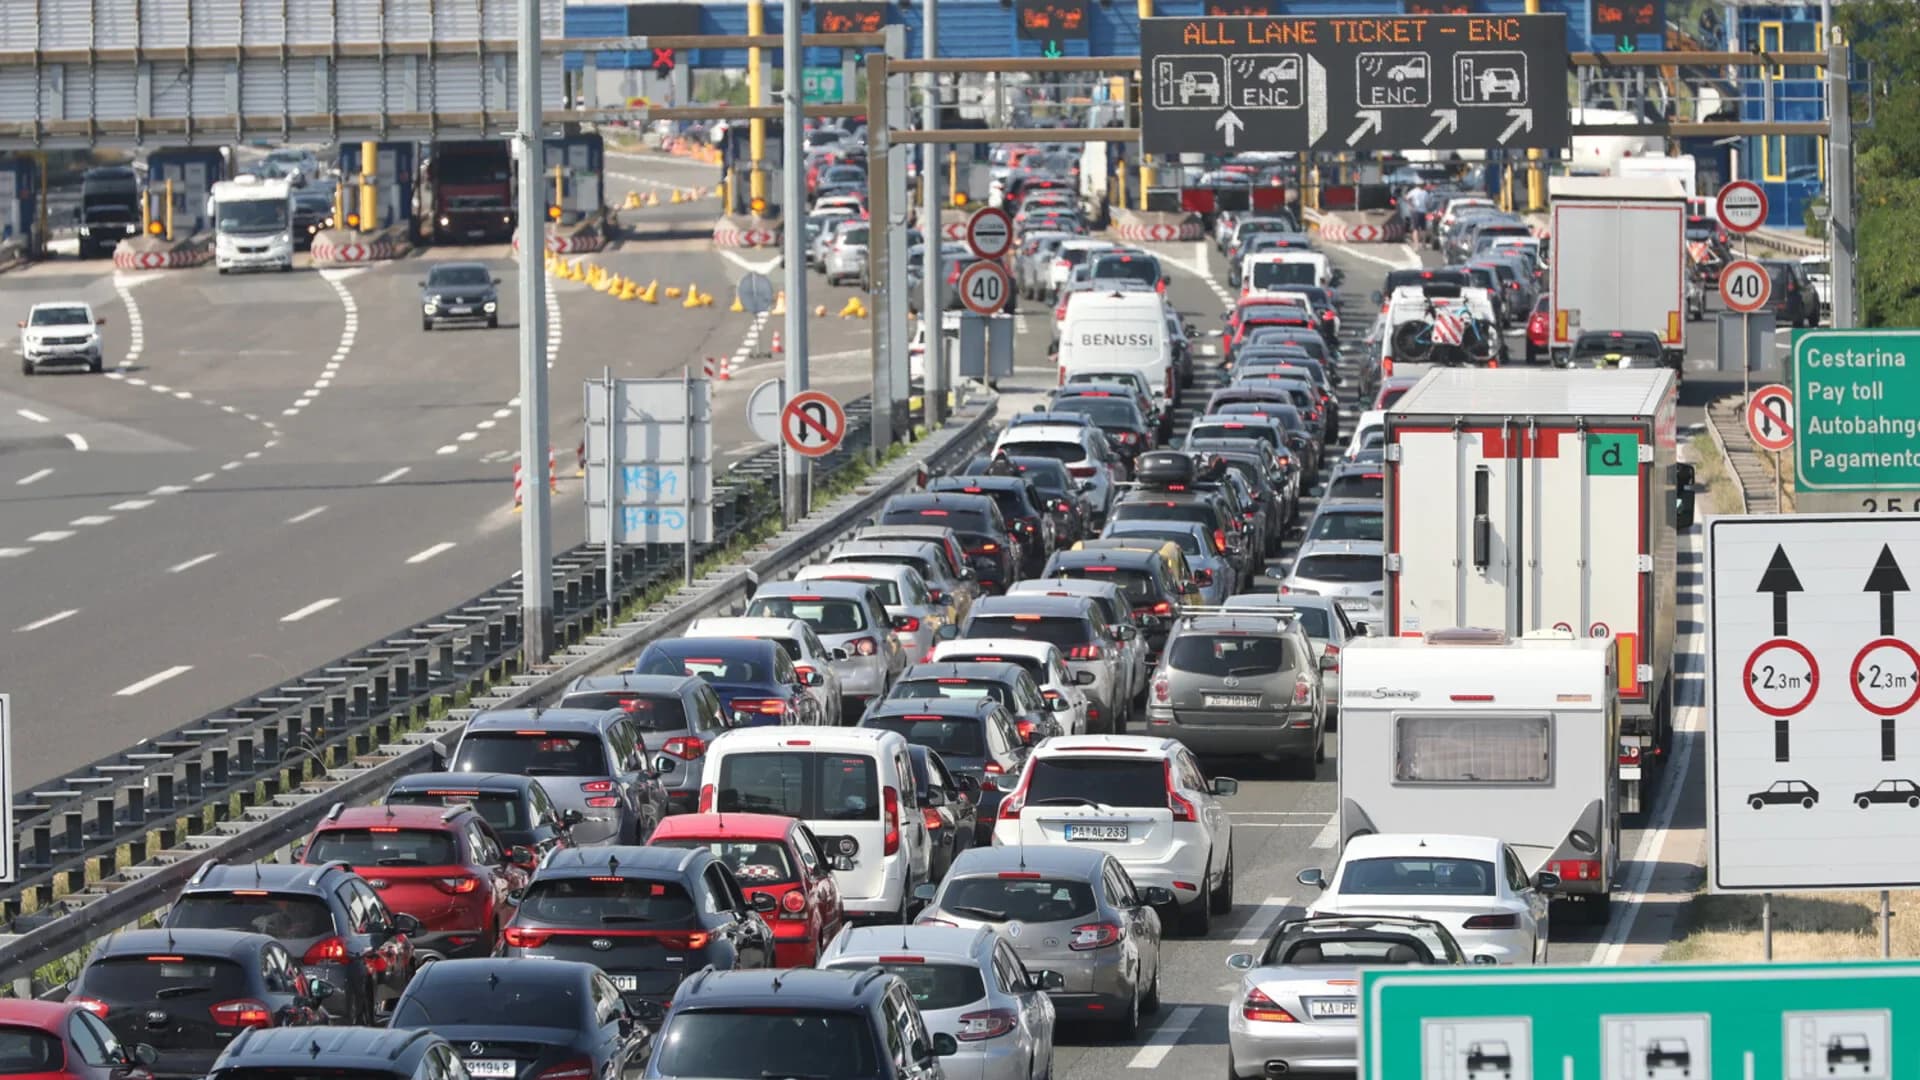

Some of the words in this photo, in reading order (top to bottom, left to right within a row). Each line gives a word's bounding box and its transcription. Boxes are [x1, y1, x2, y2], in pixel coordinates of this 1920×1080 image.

[1184, 21, 1235, 44] ALL
[1248, 20, 1317, 44] LANE
[1330, 19, 1427, 43] TICKET
[1469, 19, 1520, 41] ENC
[1243, 88, 1288, 106] ENC
[1371, 86, 1417, 105] ENC
[972, 276, 999, 300] 40
[1731, 275, 1759, 298] 40
[1082, 333, 1153, 346] BENUSSI
[1807, 348, 1906, 367] Cestarina
[1808, 381, 1845, 405] Pay
[1852, 381, 1883, 400] toll
[1808, 415, 1920, 438] Autobahng
[1601, 442, 1623, 467] d
[1107, 827, 1126, 837] 233
[1321, 1002, 1334, 1014] KA
